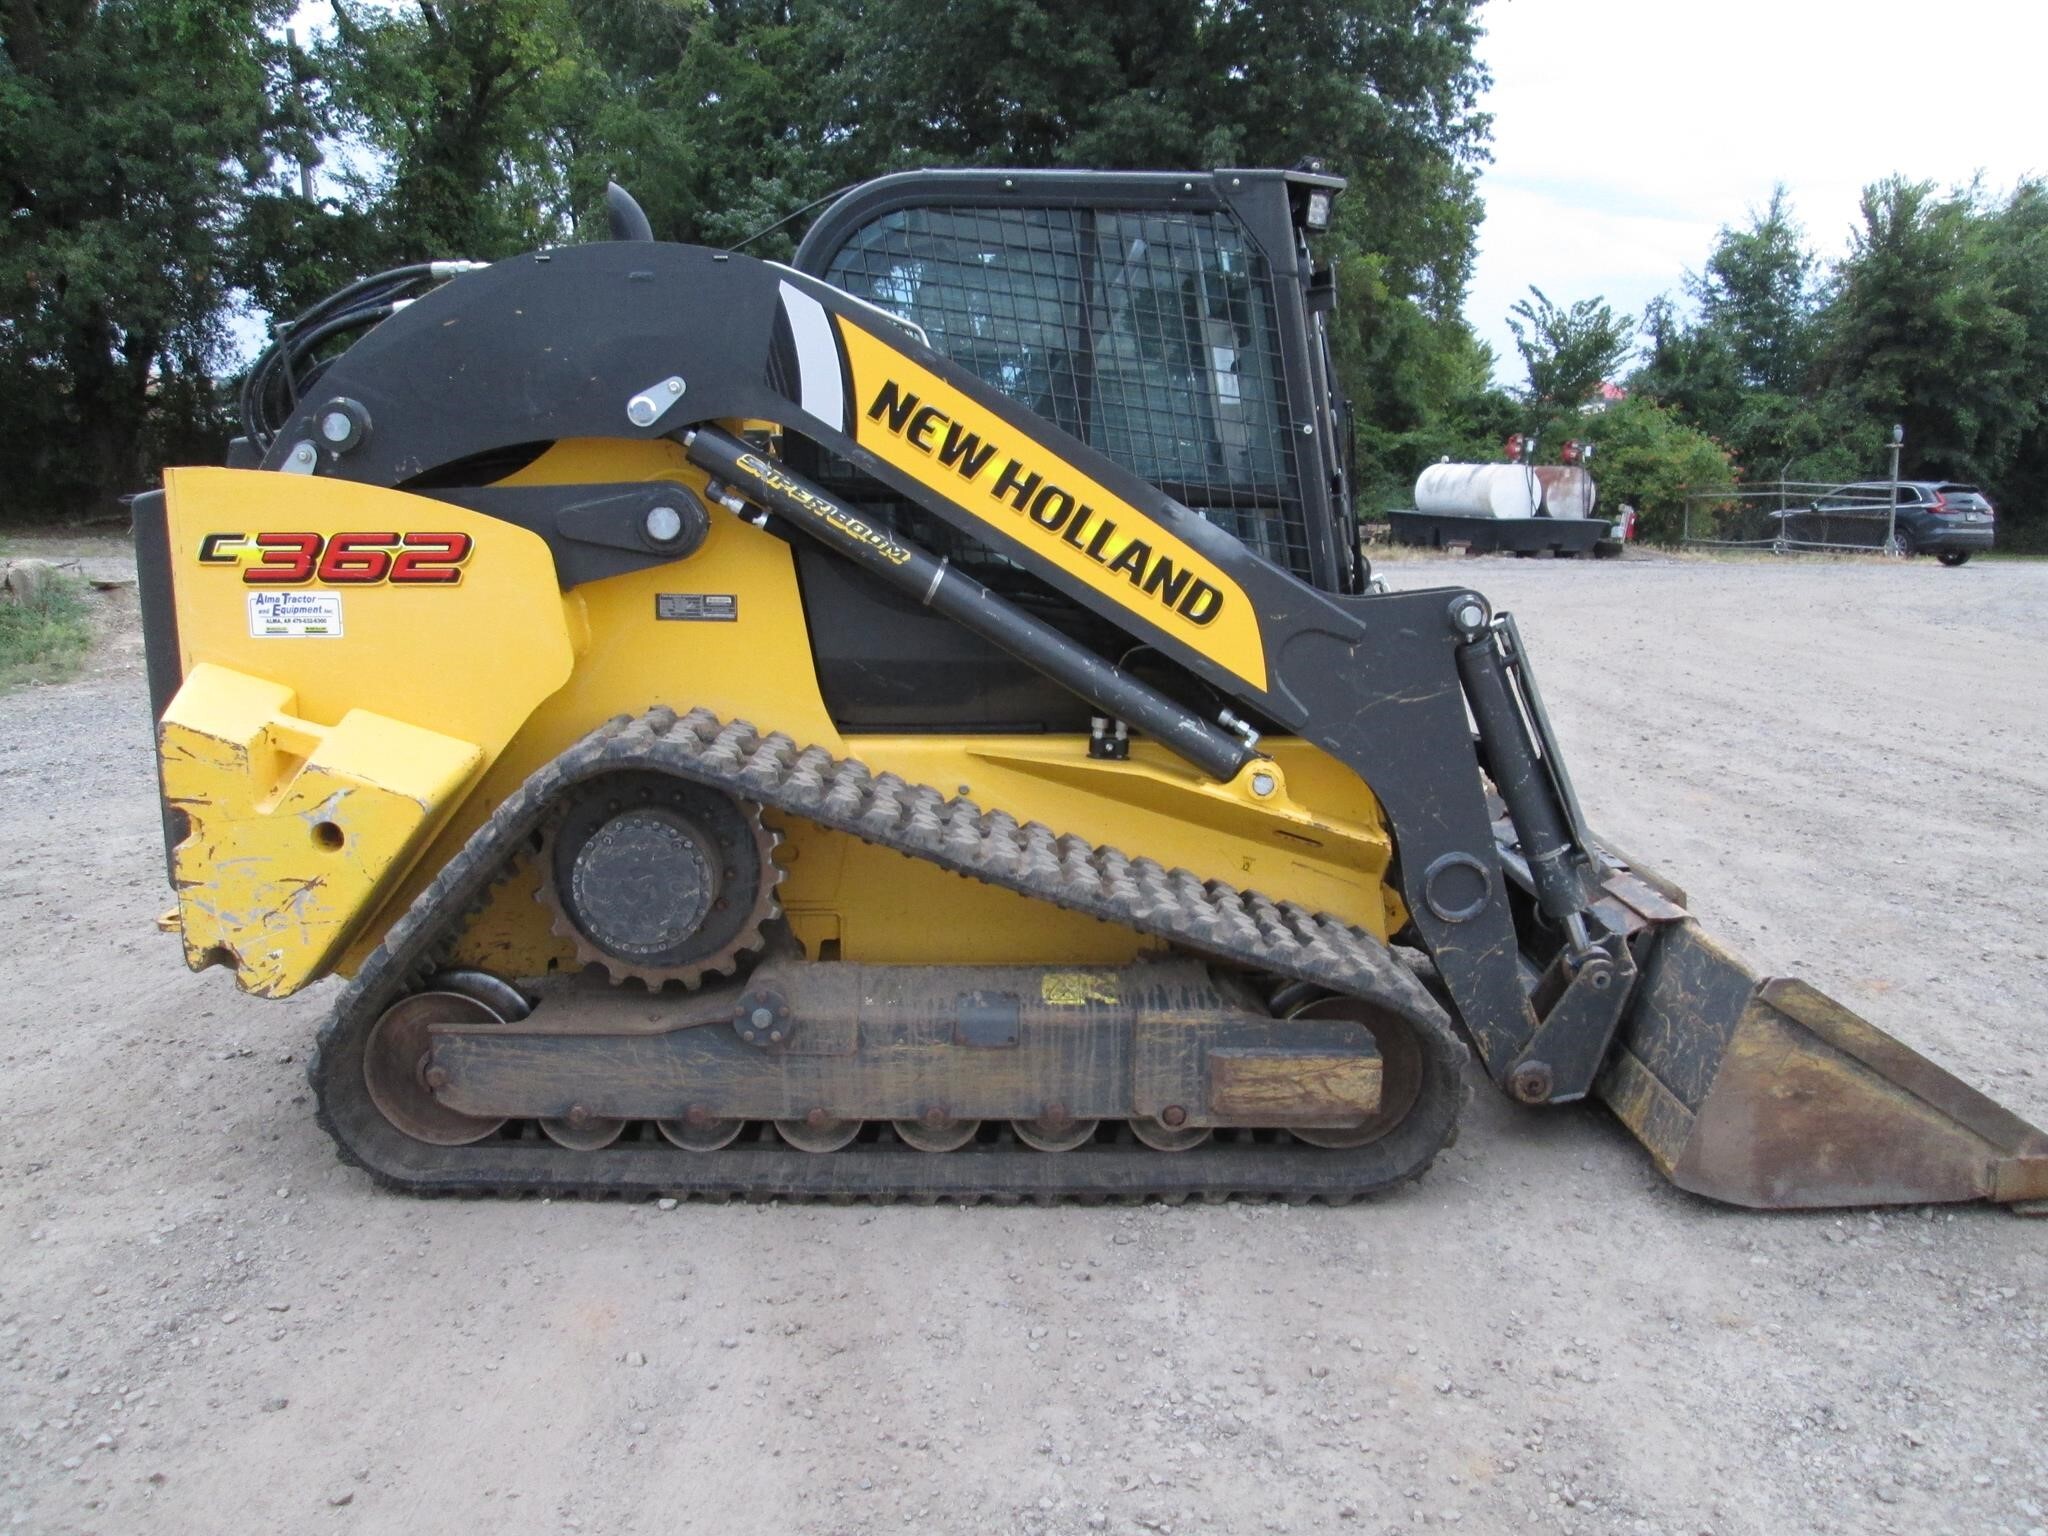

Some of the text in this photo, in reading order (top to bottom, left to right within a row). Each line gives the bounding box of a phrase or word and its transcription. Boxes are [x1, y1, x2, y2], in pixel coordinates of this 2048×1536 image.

[867, 379, 1224, 626] NEW HOLLAND
[198, 532, 474, 584] C362
[256, 592, 316, 605] Alma Tractor
[272, 604, 322, 616] Equipment
